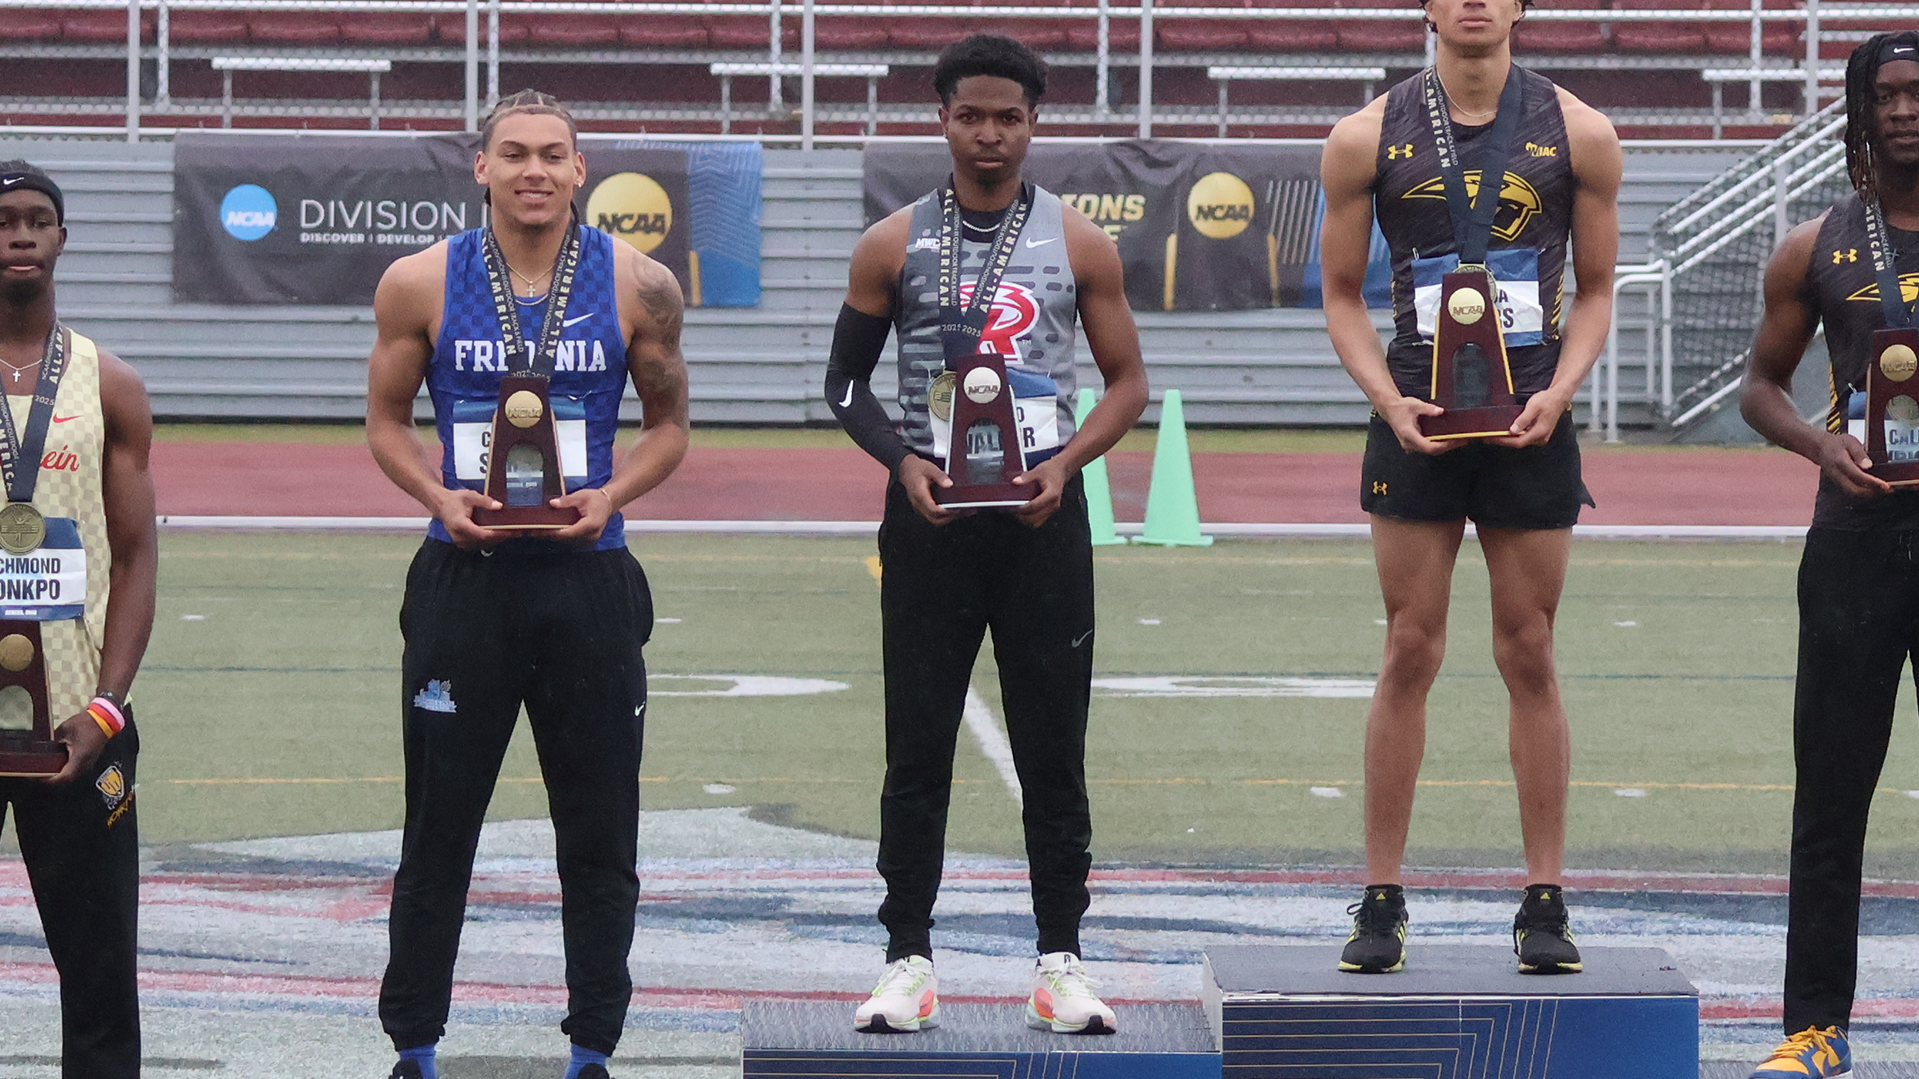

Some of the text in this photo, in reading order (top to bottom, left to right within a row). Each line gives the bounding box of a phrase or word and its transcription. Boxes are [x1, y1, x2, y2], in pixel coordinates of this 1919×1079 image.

[226, 211, 277, 228] NCAA
[301, 200, 466, 230] DIVISION
[598, 213, 666, 236] NCAA
[1195, 204, 1250, 222] NCAA
[301, 232, 435, 245] DISCOVER DEVELOP
[914, 237, 941, 249] MWC
[939, 188, 953, 306] ALL-AMERICAN
[988, 231, 1005, 261] OUTDOOR
[977, 201, 1028, 313] ALL-AMERICAN
[548, 271, 562, 303] OUTDOOR
[976, 265, 992, 292] DIVISION
[481, 236, 516, 355] ALL-AMERICAN
[544, 239, 580, 358] ALL-AMERICAN
[971, 290, 982, 309] NCAA
[501, 279, 515, 311] OUTDOOR
[509, 312, 519, 331] TRACK
[515, 335, 524, 352] FIELD
[541, 309, 552, 337] DIVISION
[1453, 305, 1484, 317] NCAA
[962, 325, 982, 339] 2025
[454, 339, 607, 372] FRENIA
[537, 337, 546, 355] NCAA
[35, 394, 55, 406] 2025
[967, 384, 999, 396] NCAA
